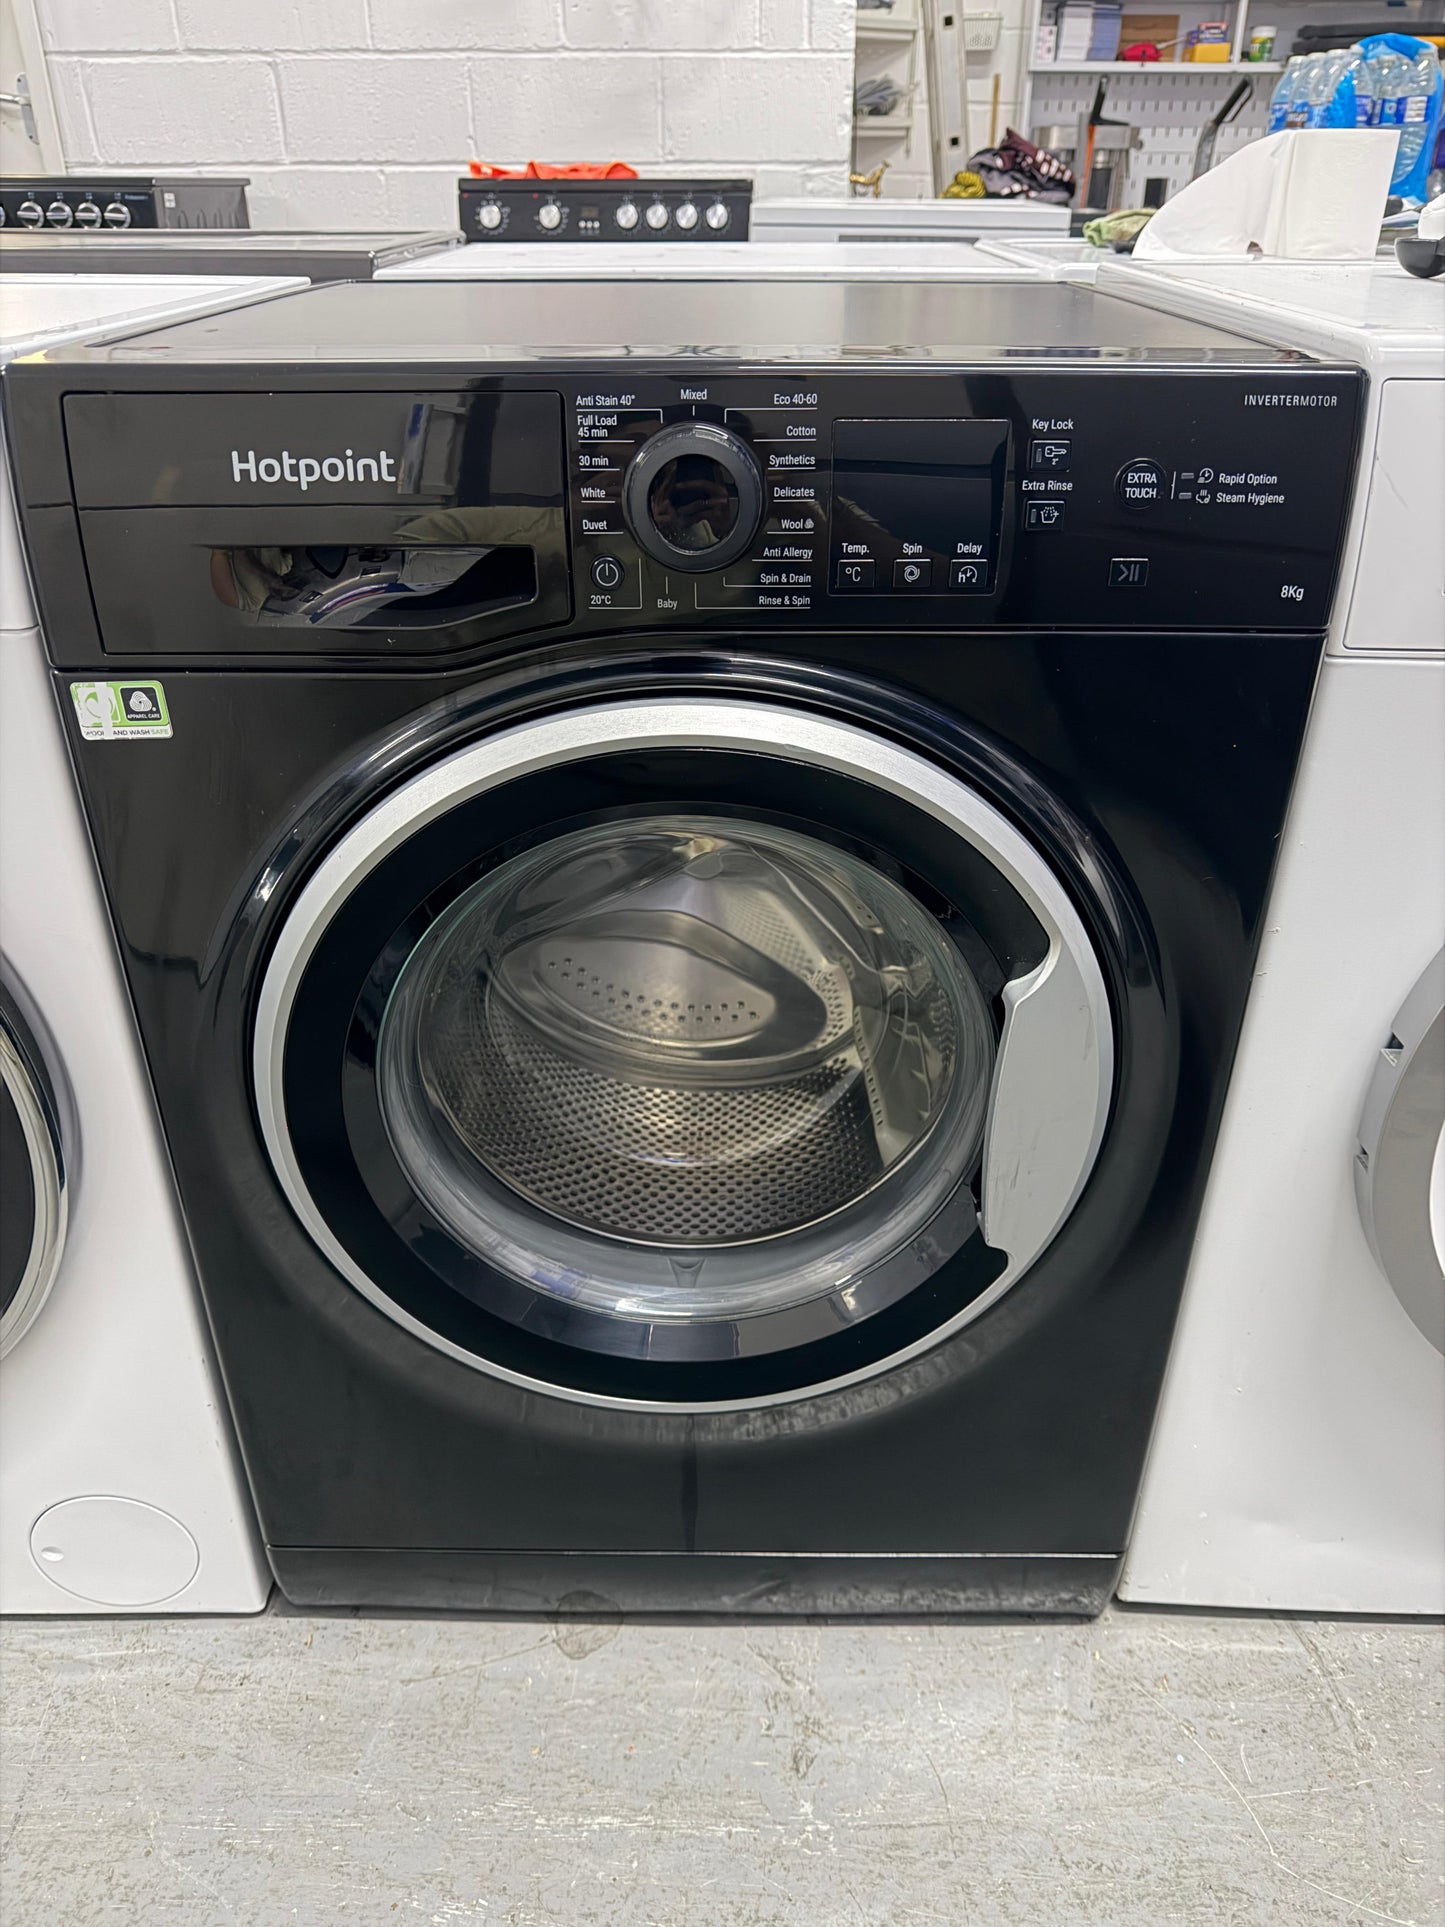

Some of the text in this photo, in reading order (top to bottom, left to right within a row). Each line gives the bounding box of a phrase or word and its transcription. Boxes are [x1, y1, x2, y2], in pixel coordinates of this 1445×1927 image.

[681, 389, 707, 400] Mixed
[774, 394, 817, 404] Eco 40-60
[576, 395, 595, 405] Anti
[596, 395, 618, 405] Stain
[1245, 395, 1337, 406] INVERTERMOTOR
[578, 415, 617, 425] Full Load
[1033, 419, 1073, 431] Key Lock
[578, 427, 608, 437] 45 min
[787, 426, 816, 436] Cotton
[579, 456, 608, 465] 30 min
[770, 455, 815, 466] Synthetics
[232, 449, 396, 490] Hotpoint
[1128, 473, 1156, 483] EXTRA
[1219, 473, 1277, 486] Rapid Option
[1022, 480, 1072, 490] Extra Rinse
[581, 488, 605, 497] White
[774, 487, 814, 497] Delicates
[1125, 488, 1156, 498] TOUCH
[1216, 493, 1284, 505] Steam Hygiene
[583, 520, 607, 529] Duvet
[782, 519, 803, 529] Wool
[763, 547, 812, 559] Anti Allergy
[842, 543, 869, 555] Temp.
[903, 543, 922, 555] Spin
[957, 543, 982, 555] Delay
[761, 574, 811, 584] Spin & Drain
[1281, 585, 1304, 601] 8Kg
[591, 595, 611, 604] 20°C
[658, 599, 677, 610] Baby
[759, 596, 810, 608] Rinse & Spin
